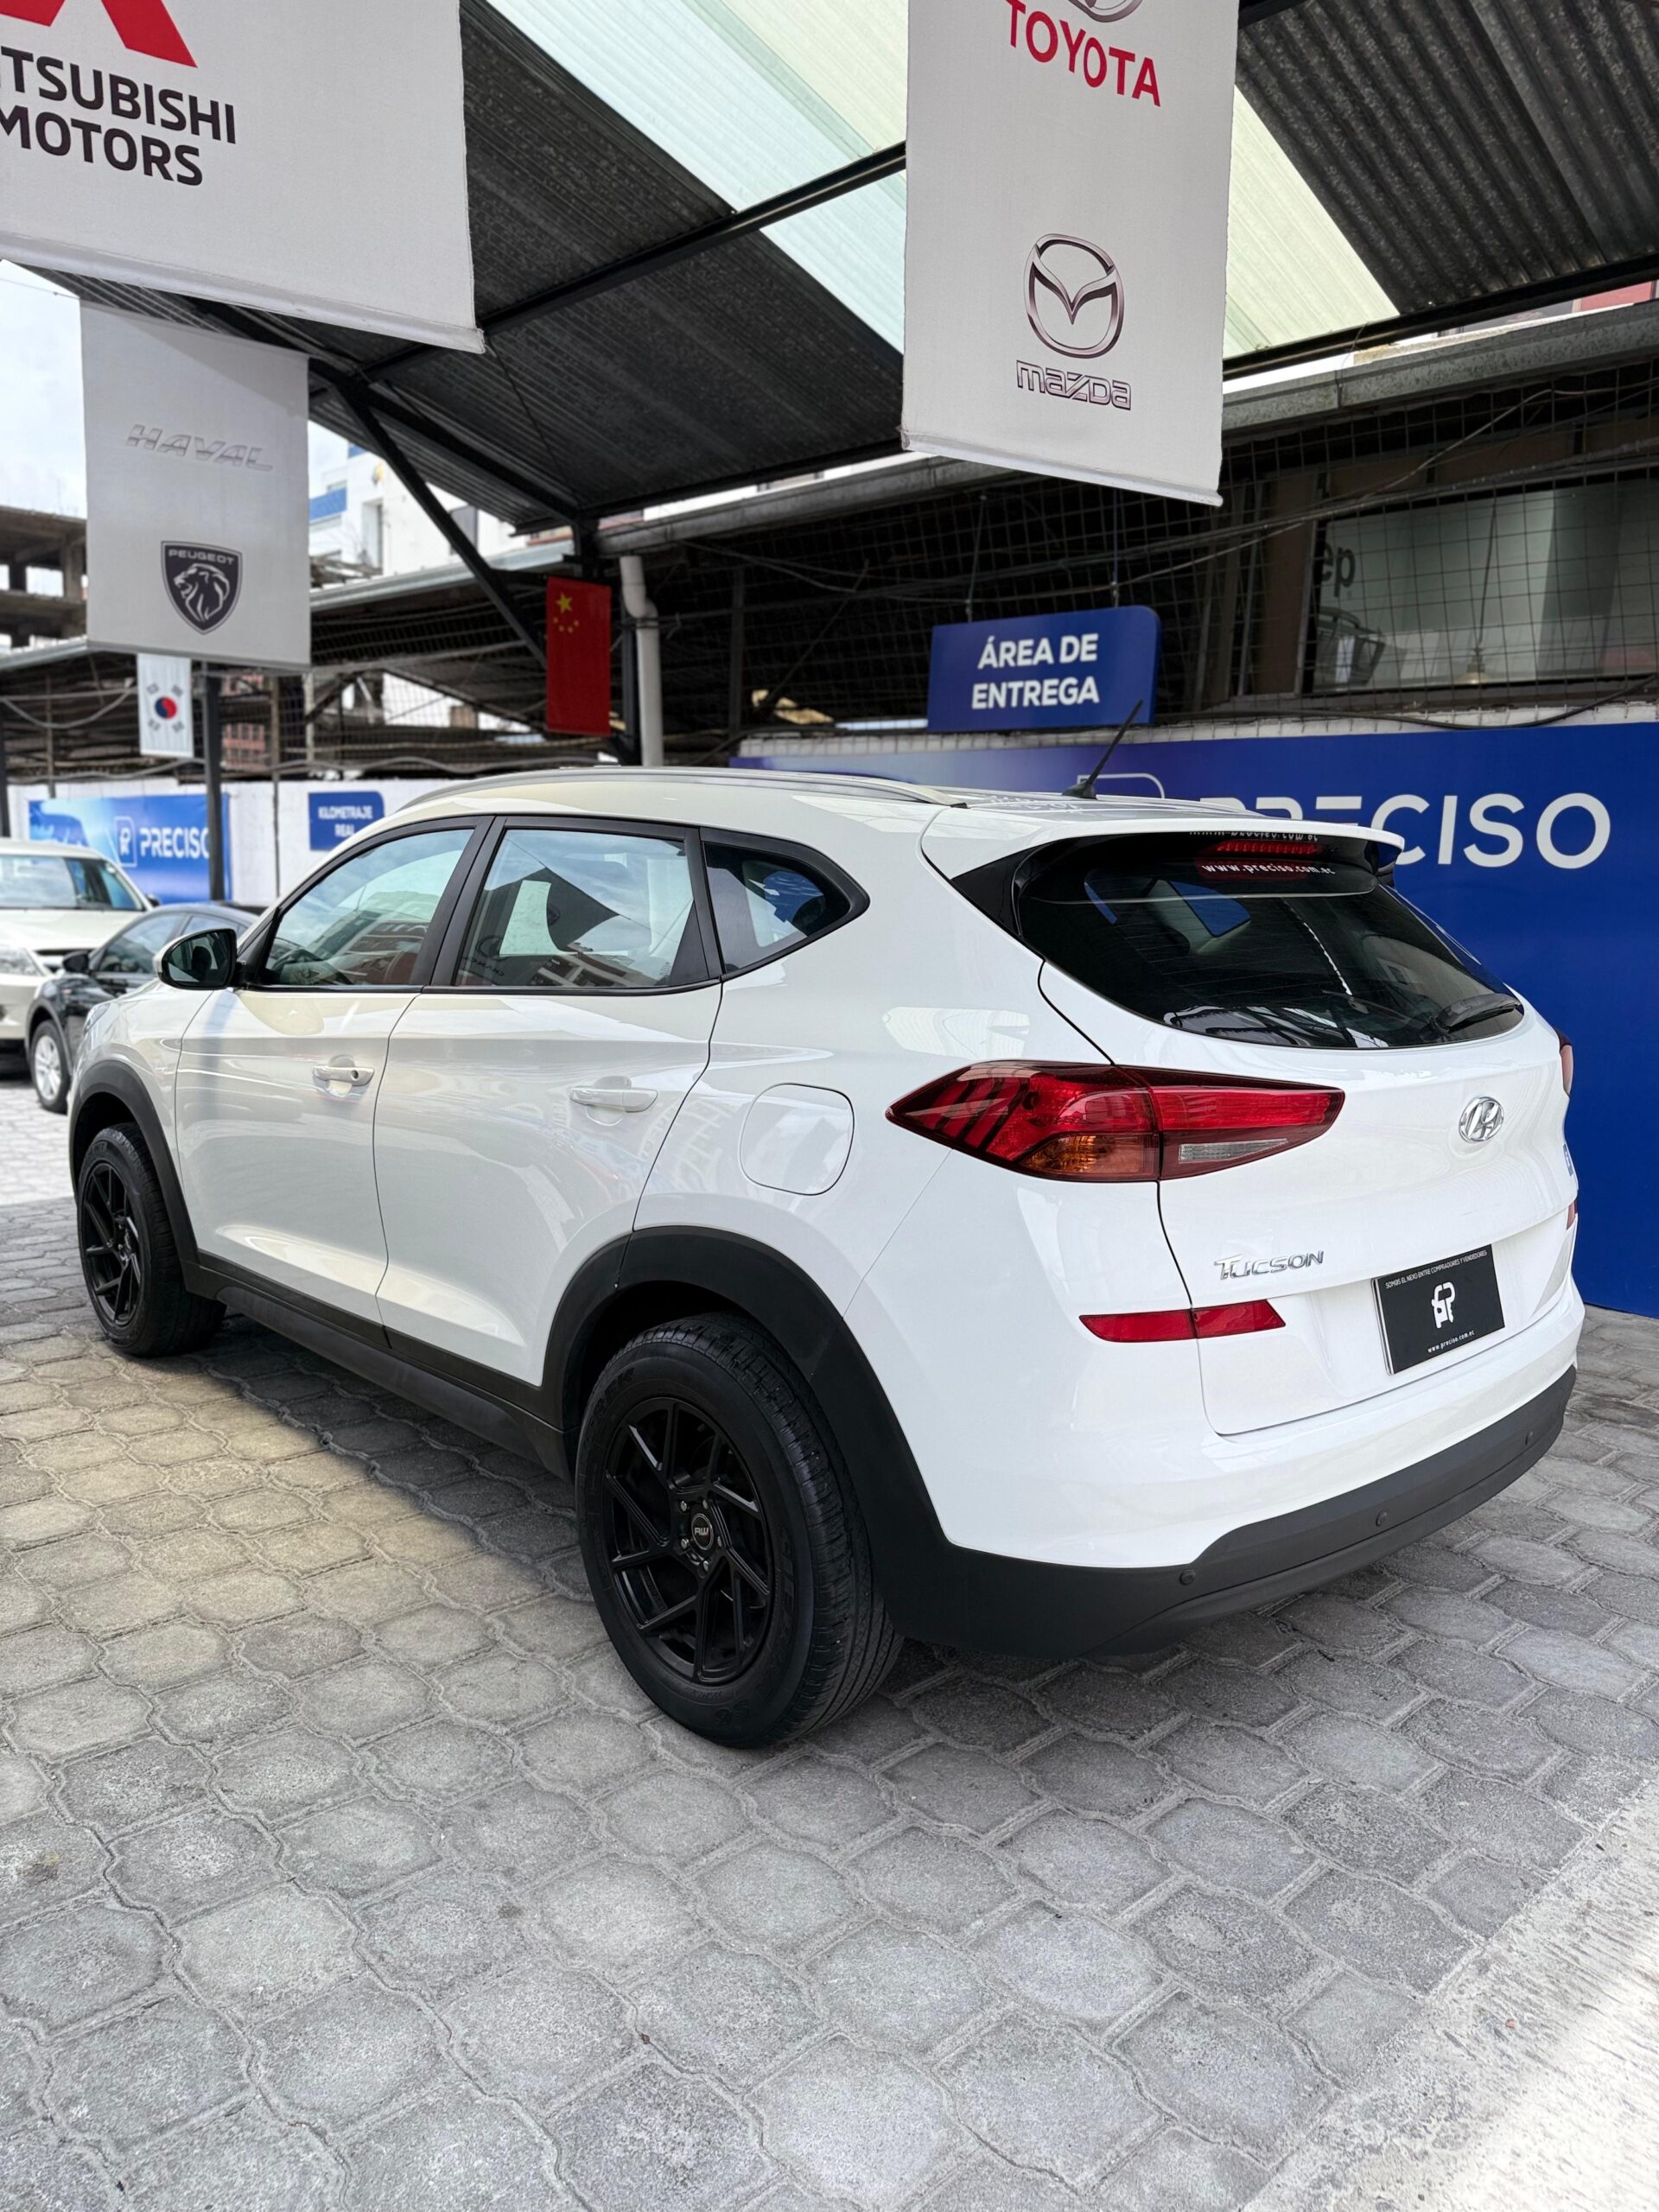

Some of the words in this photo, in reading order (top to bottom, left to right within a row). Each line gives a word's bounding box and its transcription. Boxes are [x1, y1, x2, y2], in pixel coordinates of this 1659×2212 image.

[1005, 0, 1161, 107] TOYOTA
[0, 46, 236, 144] TSUBISHI
[126, 423, 274, 472] HAVAL
[168, 549, 235, 565] PEUGEOT
[977, 635, 1054, 670] ÁREA
[1059, 632, 1099, 664] DE
[971, 676, 1100, 709] ENTREGA
[1201, 864, 1337, 875] www.preciso.com.ec
[1418, 1268, 1431, 1279] ENTRE
[1427, 1330, 1475, 1353] www.preciso.com.ec
